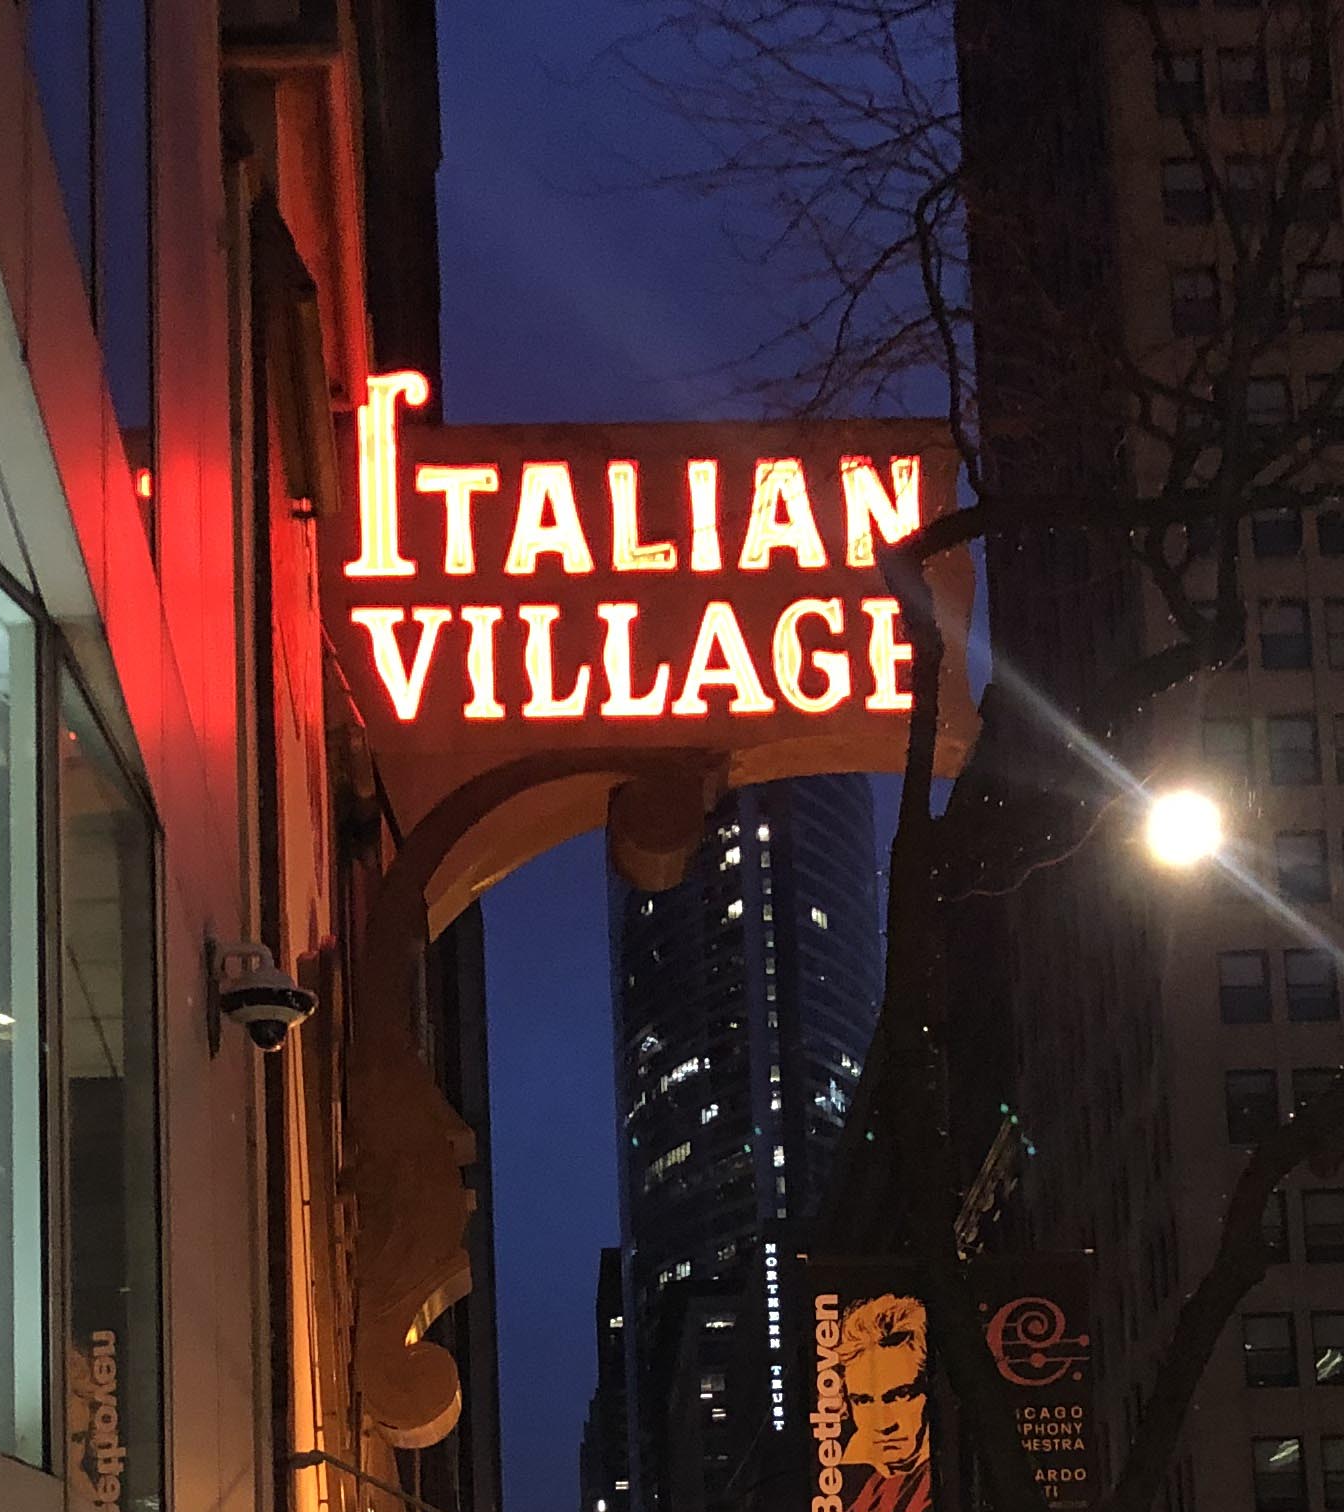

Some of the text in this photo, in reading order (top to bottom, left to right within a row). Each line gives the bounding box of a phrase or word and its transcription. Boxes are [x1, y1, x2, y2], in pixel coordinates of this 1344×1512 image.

[343, 369, 923, 576] ITALIAN
[348, 595, 917, 722] VILLAGE
[770, 1365, 785, 1431] TRUST
